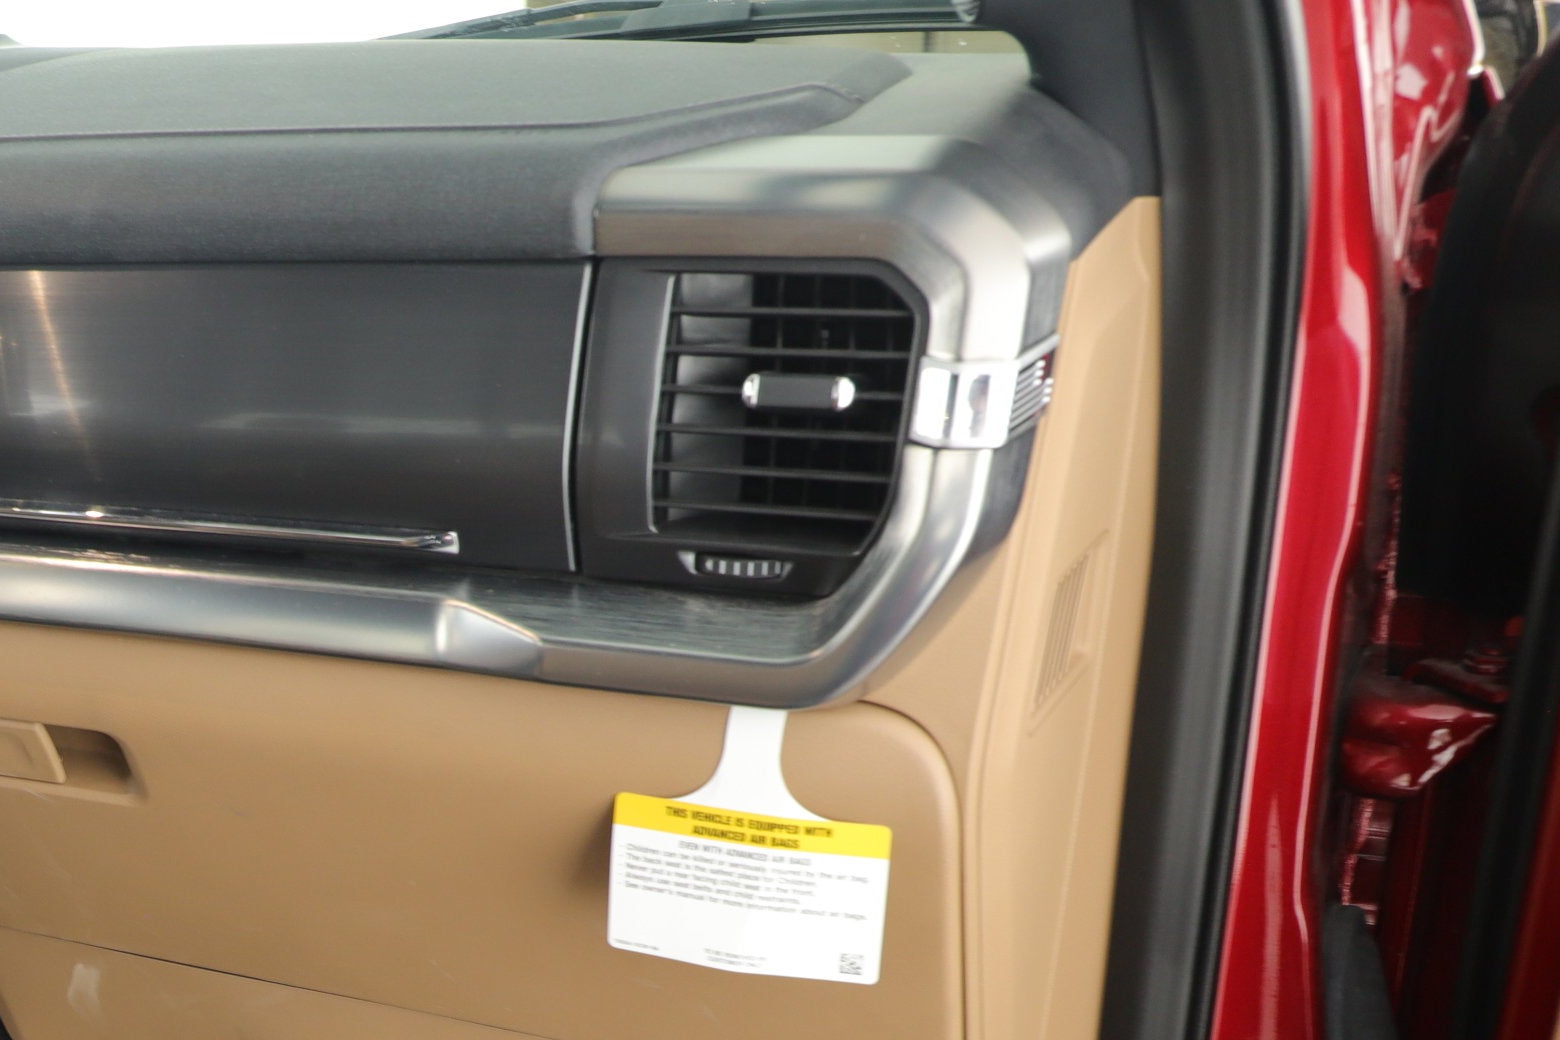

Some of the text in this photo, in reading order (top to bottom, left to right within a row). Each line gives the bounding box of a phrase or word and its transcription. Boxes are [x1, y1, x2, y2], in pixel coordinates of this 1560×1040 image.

[665, 805, 688, 819] THIS
[691, 809, 732, 826] VEHICLE
[692, 825, 801, 850] ADVANCED AIR BAGS
